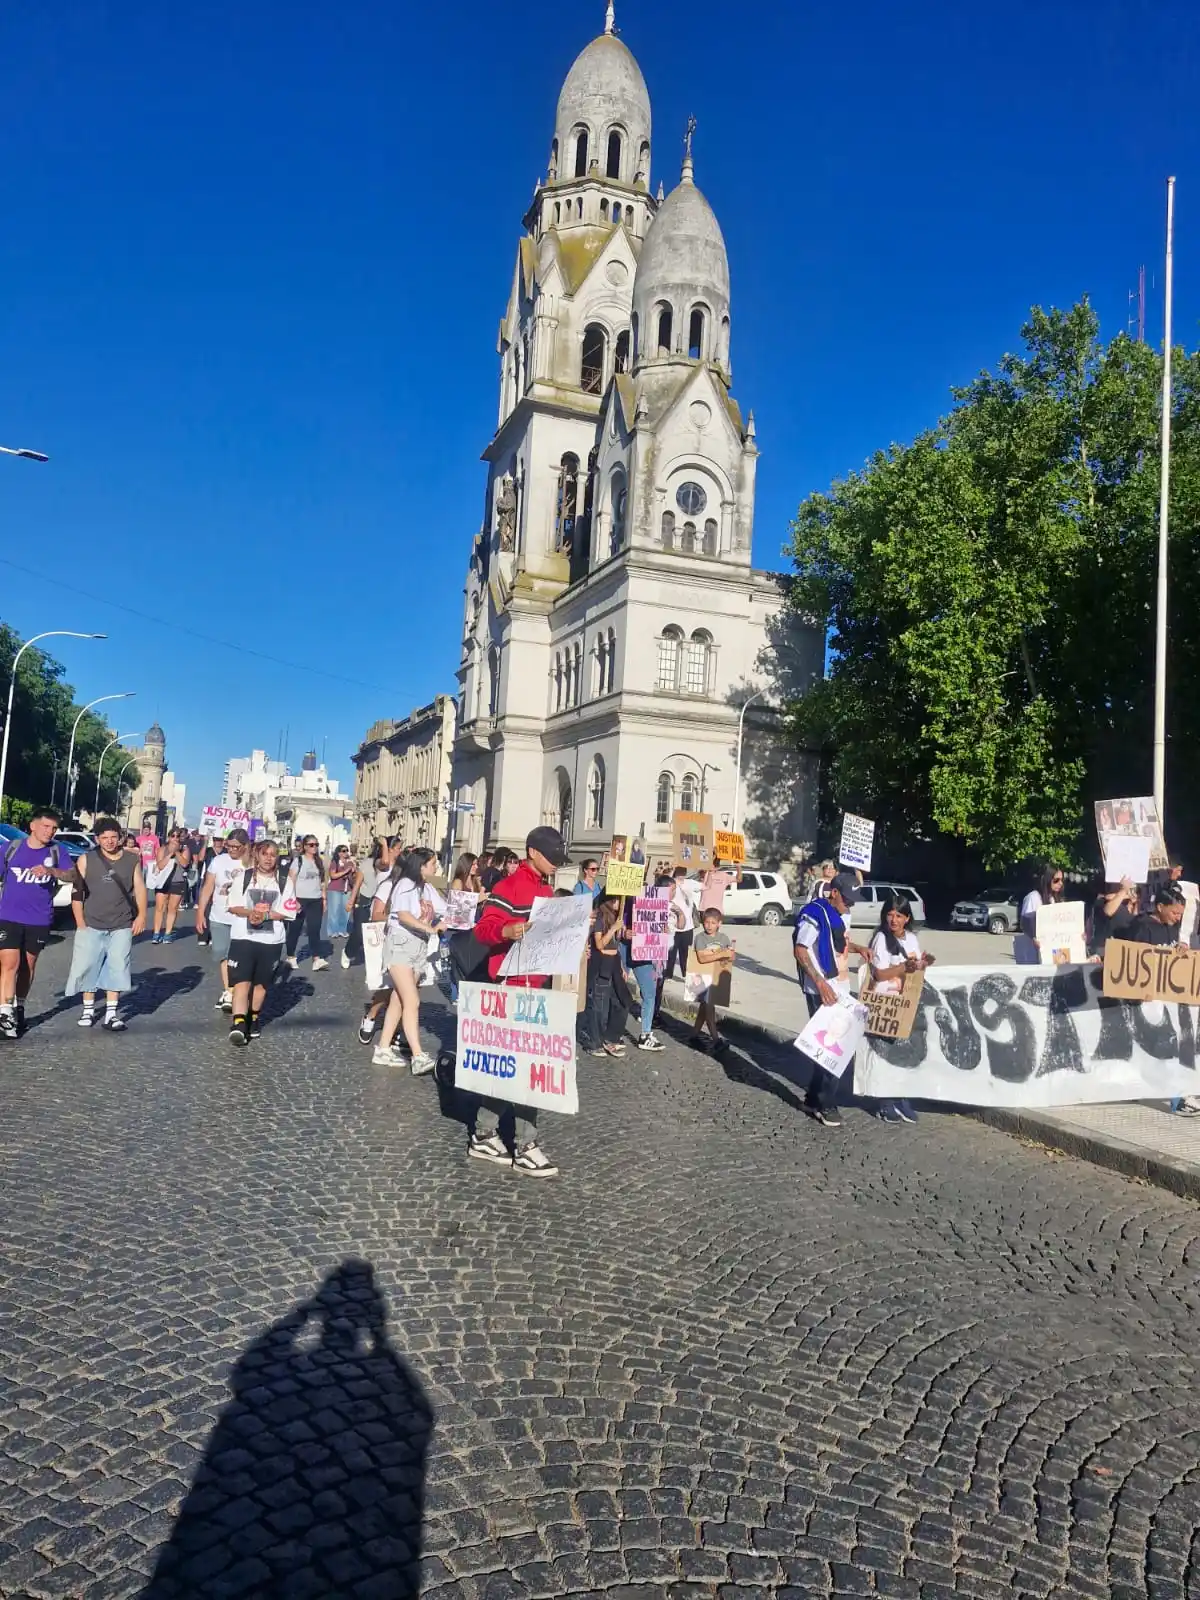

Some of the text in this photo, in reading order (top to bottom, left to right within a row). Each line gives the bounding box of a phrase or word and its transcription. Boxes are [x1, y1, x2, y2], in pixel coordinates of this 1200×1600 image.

[203, 806, 250, 821] JUSTICIA
[462, 988, 474, 1013] Y
[480, 989, 507, 1019] UN
[862, 991, 911, 1009] JUSTICIA
[461, 1018, 572, 1062] CORONAREMOS
[867, 972, 1200, 1084] JUSTICI
